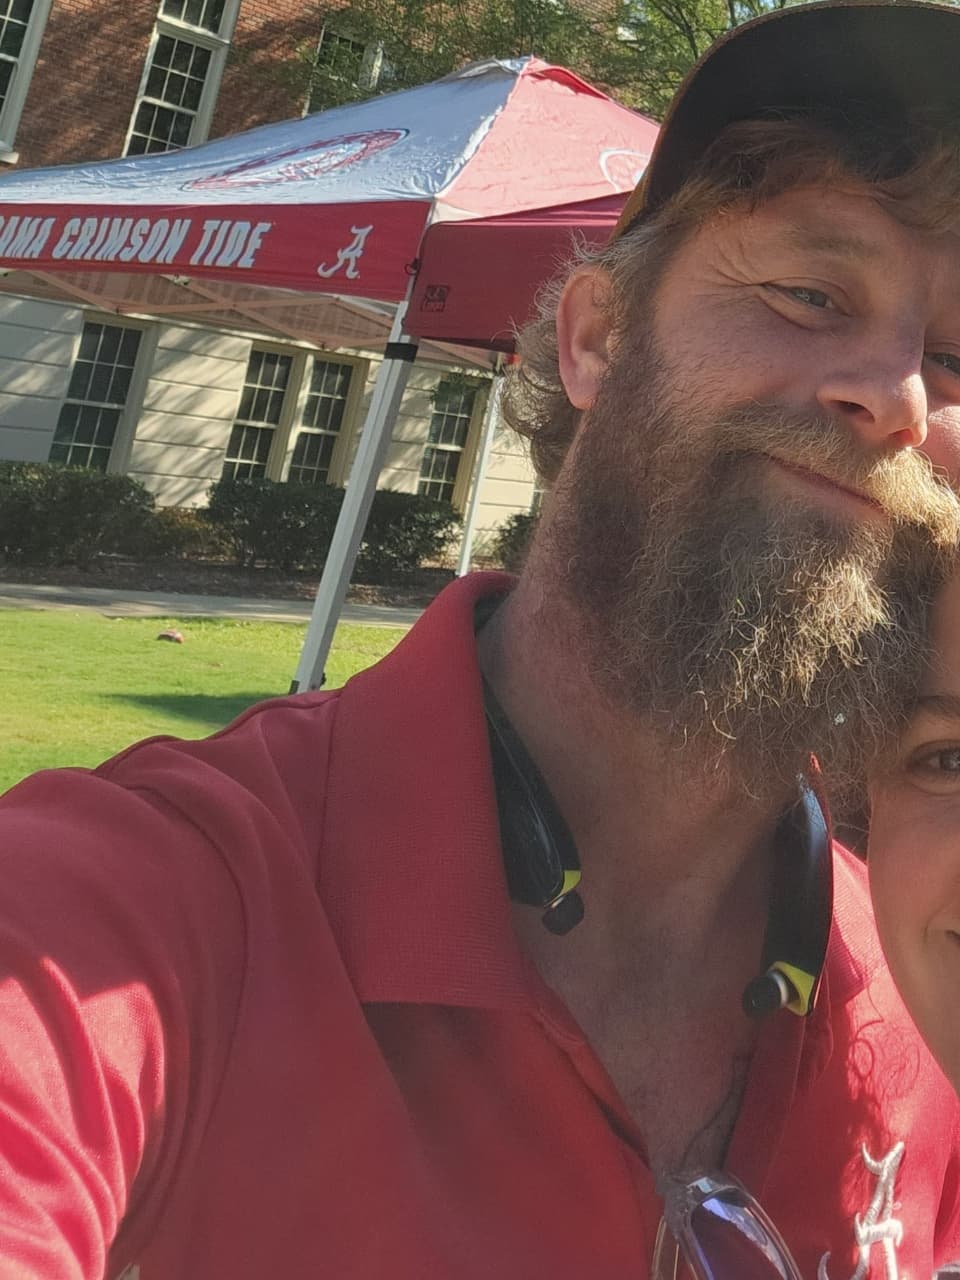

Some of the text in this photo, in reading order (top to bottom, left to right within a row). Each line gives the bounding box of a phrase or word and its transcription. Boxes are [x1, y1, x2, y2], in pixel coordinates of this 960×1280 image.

[0, 216, 271, 267] AMA CRIMSON TIDE
[317, 225, 373, 278] A
